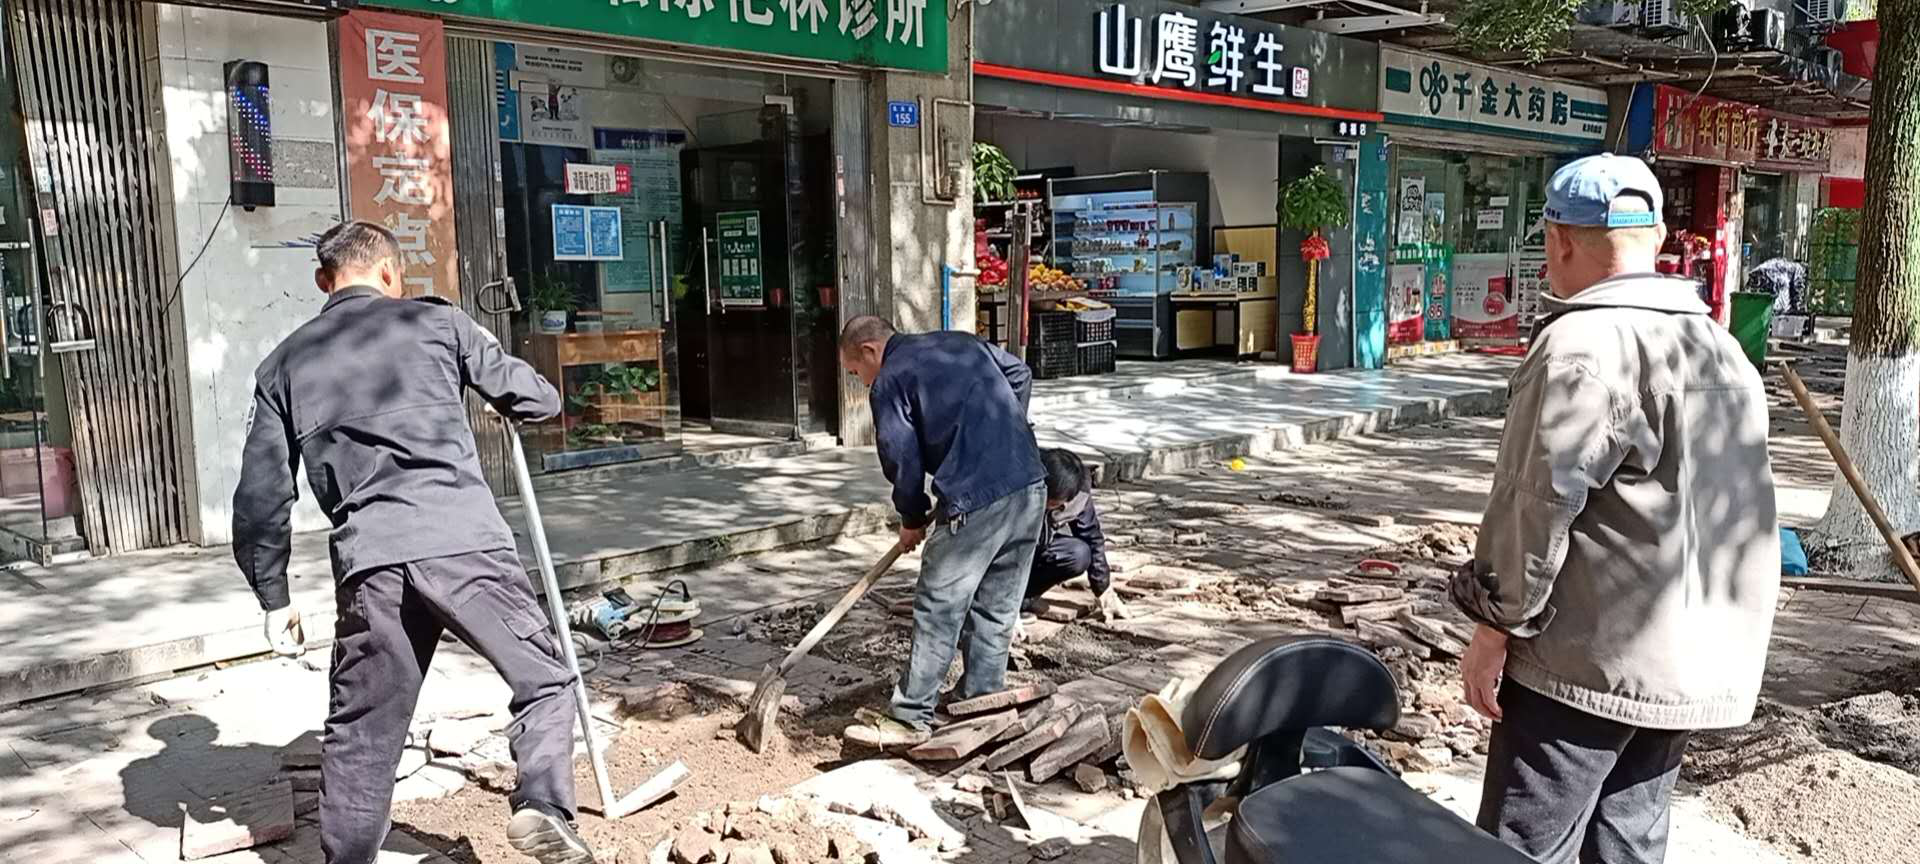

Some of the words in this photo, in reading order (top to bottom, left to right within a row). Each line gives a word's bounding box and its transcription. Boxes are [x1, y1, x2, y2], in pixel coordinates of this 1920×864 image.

[610, 0, 926, 49] 林诊所
[1099, 3, 1285, 96] 山鹰鲜生
[895, 113, 912, 124] 155
[1452, 72, 1569, 126] 千金大药房
[365, 27, 436, 298] 医保定点
